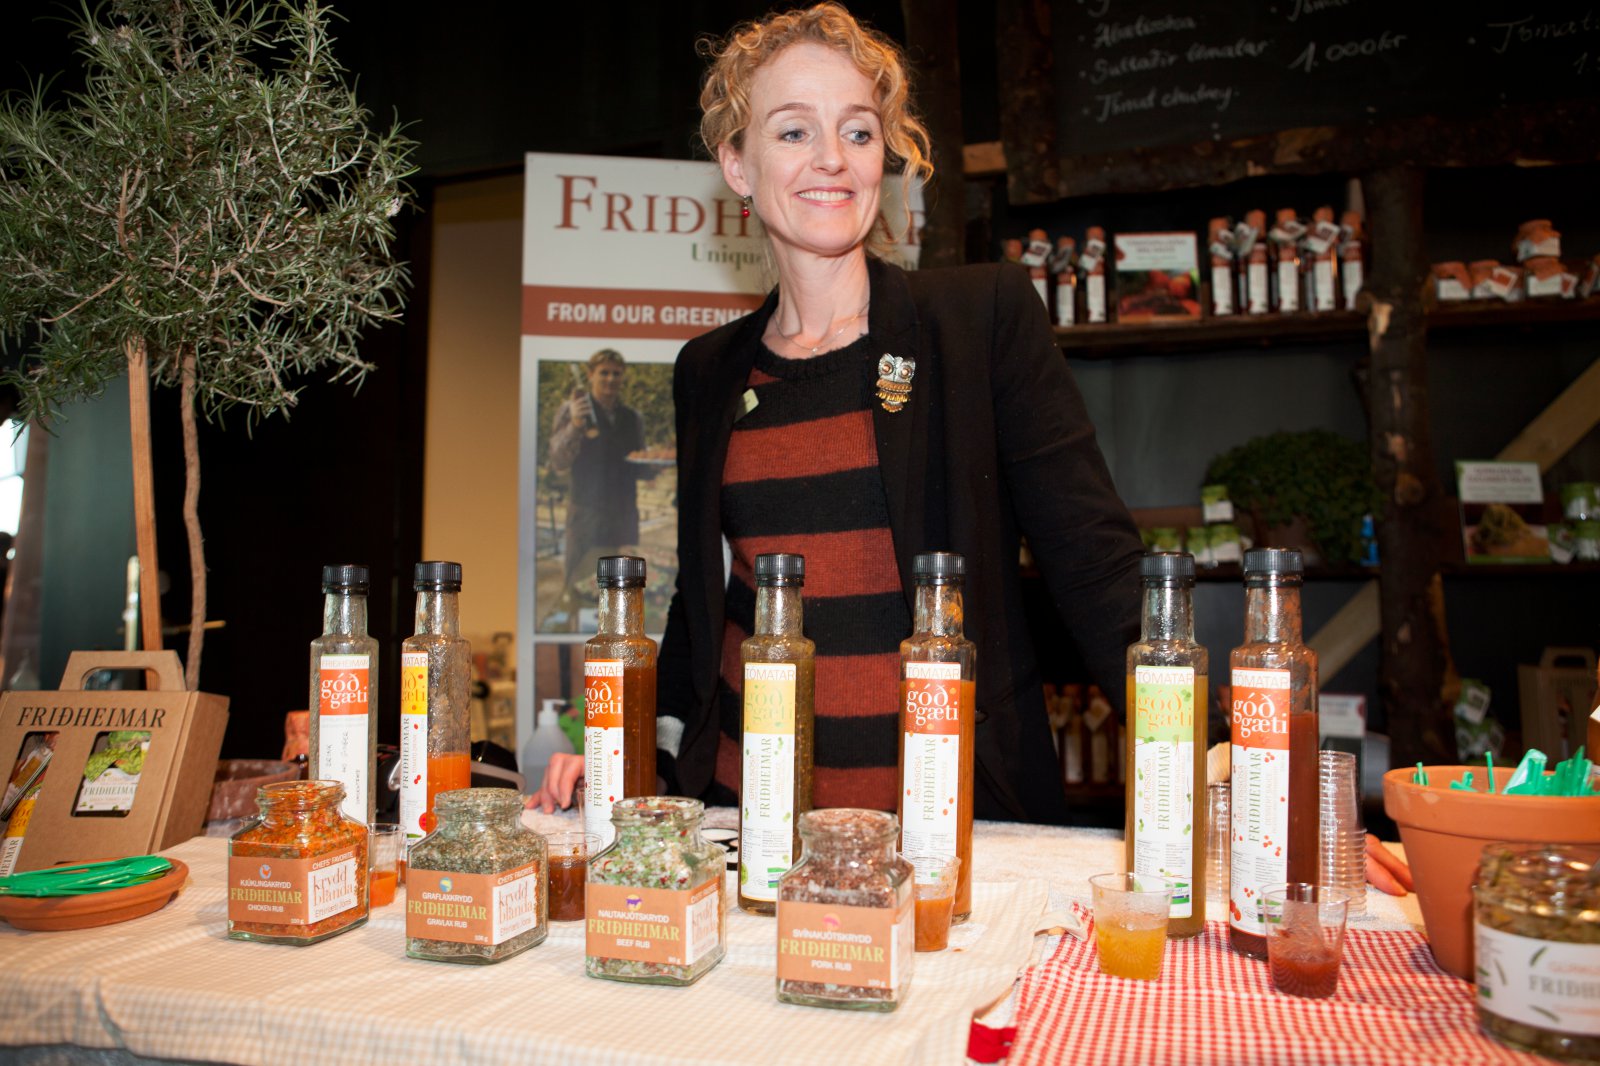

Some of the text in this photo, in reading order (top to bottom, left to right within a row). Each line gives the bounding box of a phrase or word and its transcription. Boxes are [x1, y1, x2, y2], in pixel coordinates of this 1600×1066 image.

[546, 302, 606, 323] FROM
[611, 304, 656, 324] OUR
[321, 672, 360, 699] góð
[1136, 669, 1194, 684] TÓMATAR
[330, 686, 368, 709] gæti
[588, 697, 623, 720] gæti
[906, 683, 949, 712] góð
[1233, 692, 1275, 723] góð
[915, 701, 958, 726] gæti
[1240, 713, 1288, 738] gæti
[247, 904, 284, 913] CHICKEN RUB
